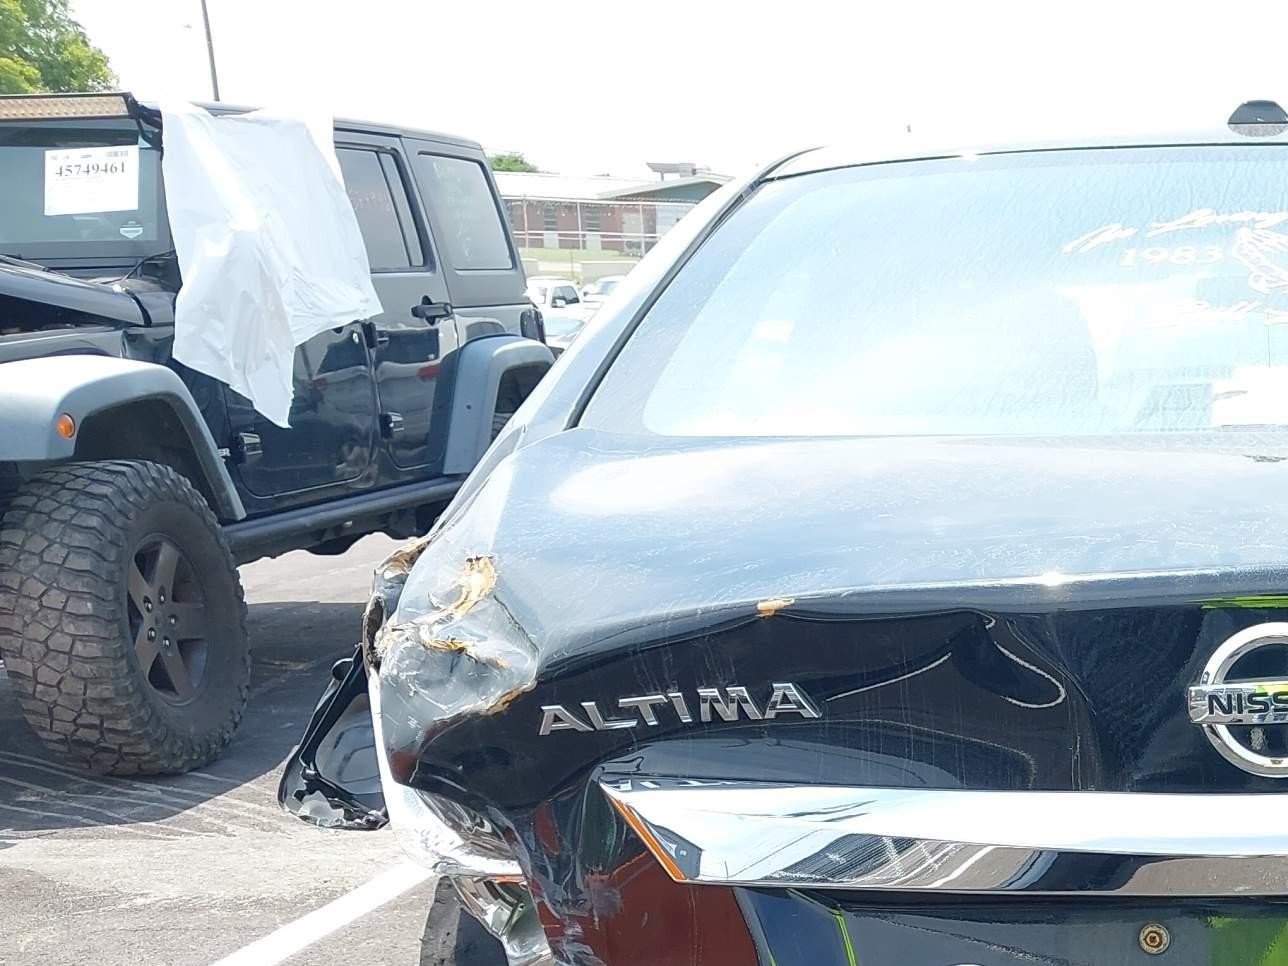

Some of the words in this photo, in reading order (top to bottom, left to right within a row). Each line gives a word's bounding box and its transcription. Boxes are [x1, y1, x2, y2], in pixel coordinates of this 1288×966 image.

[55, 161, 126, 177] 45749461
[1119, 246, 1225, 266] 1983
[539, 683, 824, 736] ALTIMA
